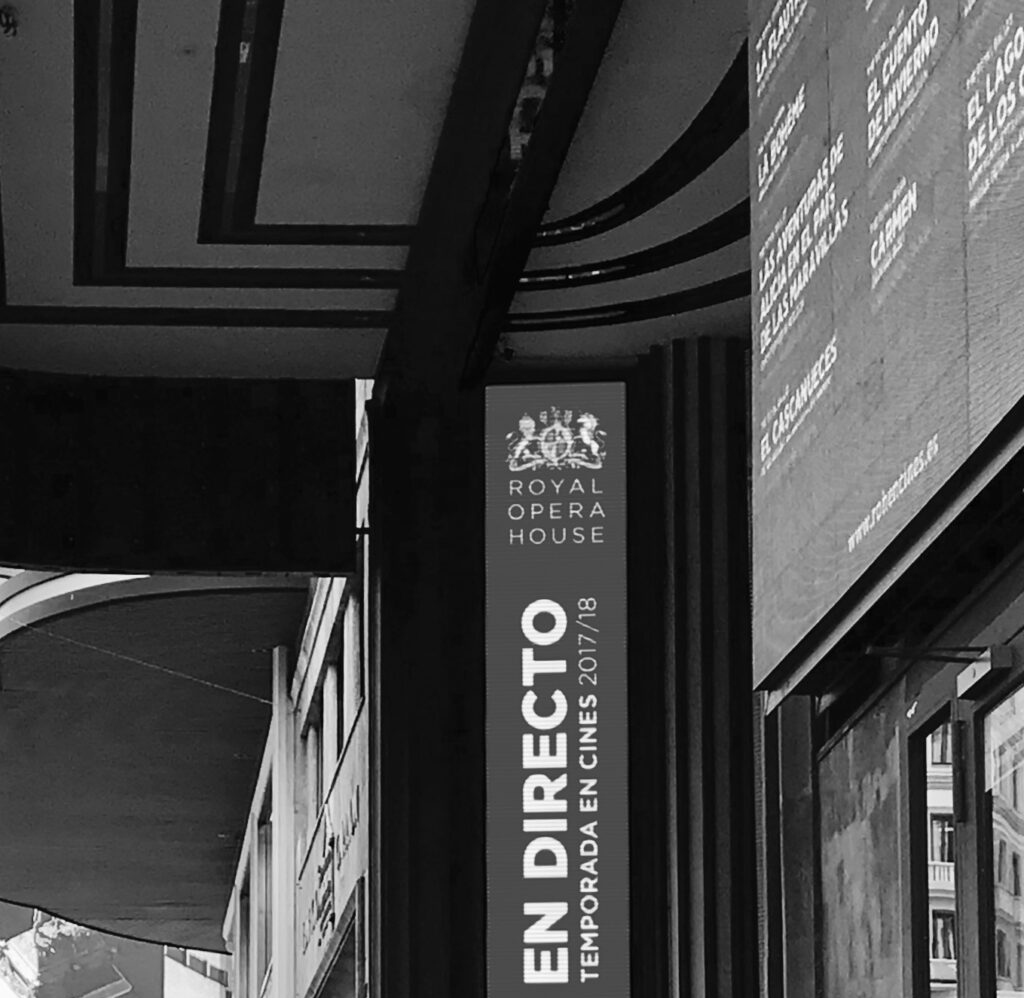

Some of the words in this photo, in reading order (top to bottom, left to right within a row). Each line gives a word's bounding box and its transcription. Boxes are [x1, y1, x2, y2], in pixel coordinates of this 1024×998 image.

[756, 49, 768, 83] LA
[867, 77, 881, 113] EL
[882, 0, 928, 87] CUENTO
[867, 117, 882, 151] DE
[883, 16, 939, 123] INVIERNO
[967, 91, 984, 131] EL
[986, 26, 1024, 104] LAGO
[758, 152, 769, 188] LA
[968, 124, 987, 171] DE
[989, 81, 1017, 143] LOS
[759, 249, 775, 292] LAS
[776, 156, 829, 264] AVENTURAS
[830, 132, 844, 175] DE
[871, 182, 918, 269] CARMEN
[759, 263, 787, 324] ALICIA
[788, 240, 800, 278] EN
[801, 224, 813, 255] EL
[760, 320, 773, 355] DE
[773, 292, 789, 335] LAS
[789, 198, 849, 309] MARAVILLAS
[760, 432, 772, 462] EL
[772, 332, 838, 445] CASCANUECES
[507, 501, 606, 521] OPERA
[509, 478, 604, 496] ROYAL
[509, 526, 604, 545] HOUSE
[576, 597, 599, 686] 2017/18
[520, 598, 569, 879] DIRECTO
[578, 694, 598, 770] CINES
[579, 778, 599, 813] EN
[522, 901, 569, 984] EN
[579, 820, 600, 984] TEMPORADA
